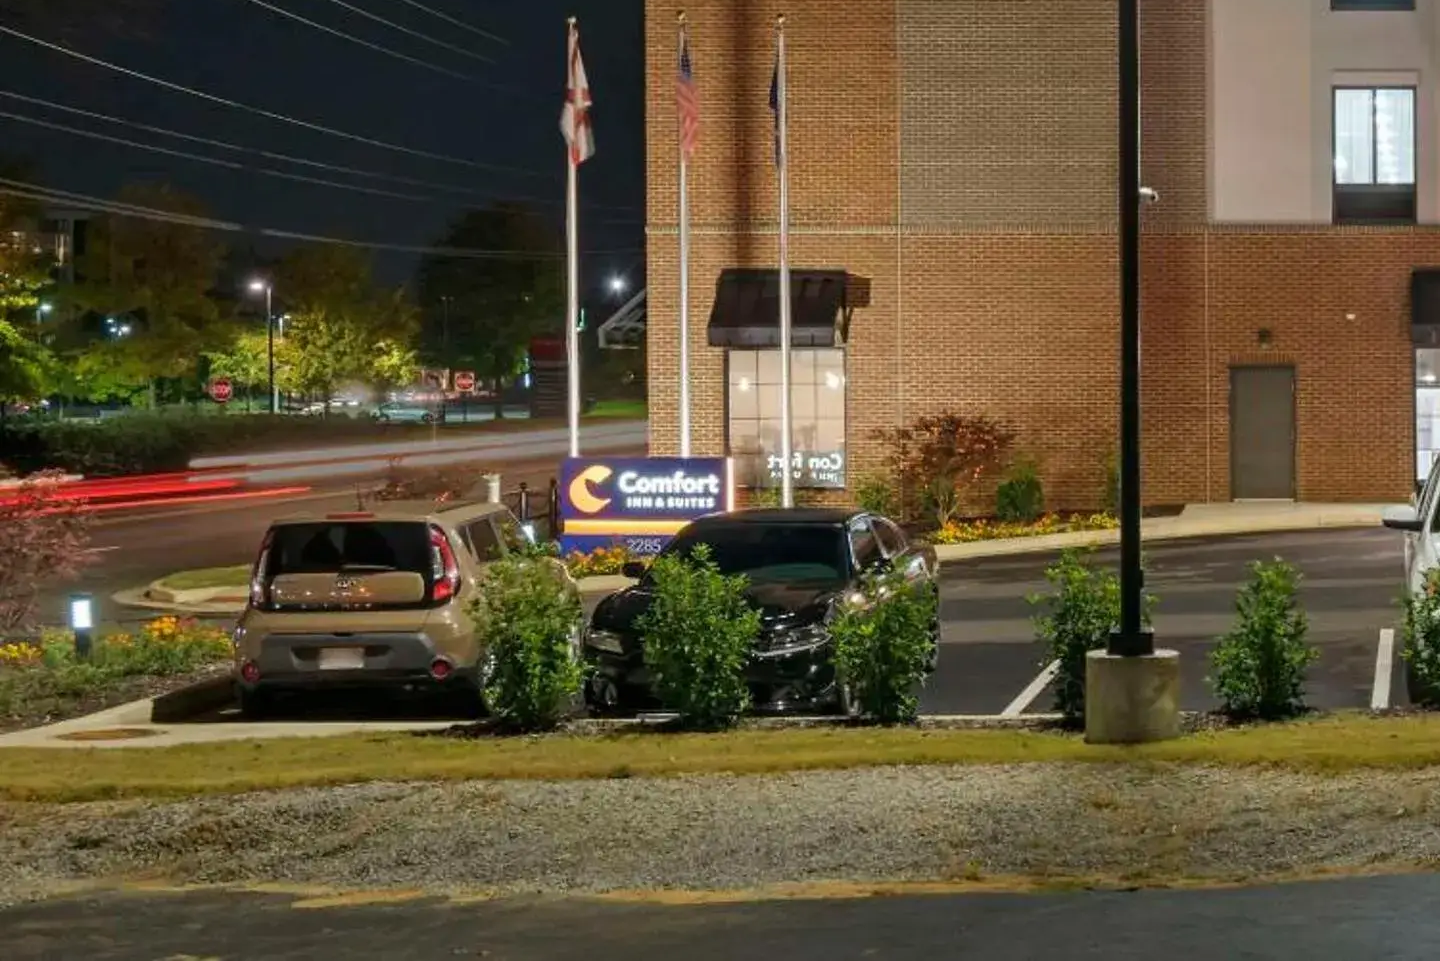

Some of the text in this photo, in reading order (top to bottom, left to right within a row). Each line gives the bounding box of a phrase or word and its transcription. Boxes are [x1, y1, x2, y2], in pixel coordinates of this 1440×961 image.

[618, 471, 719, 494] Comfort
[626, 497, 653, 508] INN
[667, 497, 715, 508] SUITES
